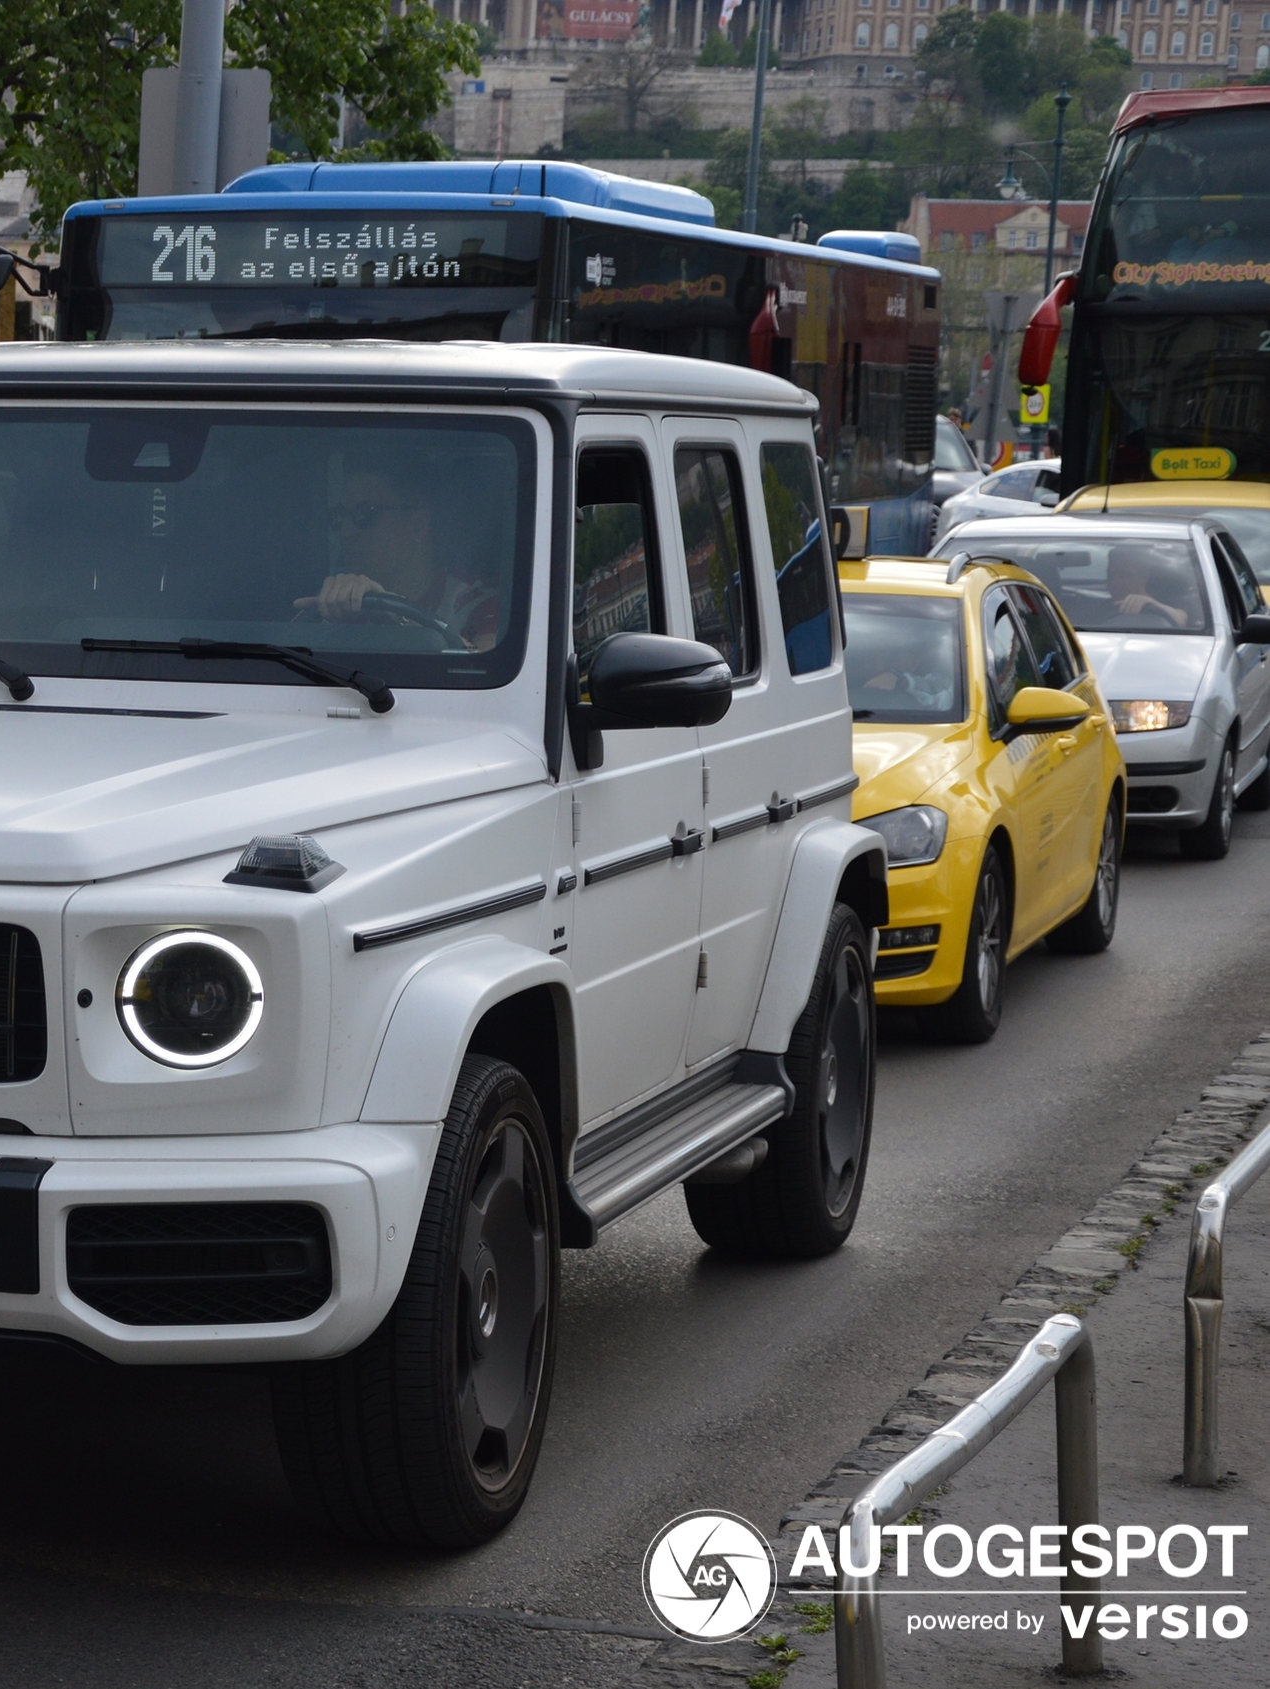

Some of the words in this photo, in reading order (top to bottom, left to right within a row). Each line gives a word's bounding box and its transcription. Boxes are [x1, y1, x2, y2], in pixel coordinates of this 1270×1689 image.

[570, 9, 634, 24] GULÁCSY
[264, 223, 438, 250] Felszállás
[152, 225, 216, 282] 216
[240, 261, 275, 279] az
[288, 253, 359, 279] első
[373, 252, 461, 280] ajtón
[1162, 457, 1189, 473] Bolt
[1193, 456, 1221, 470] Taxi
